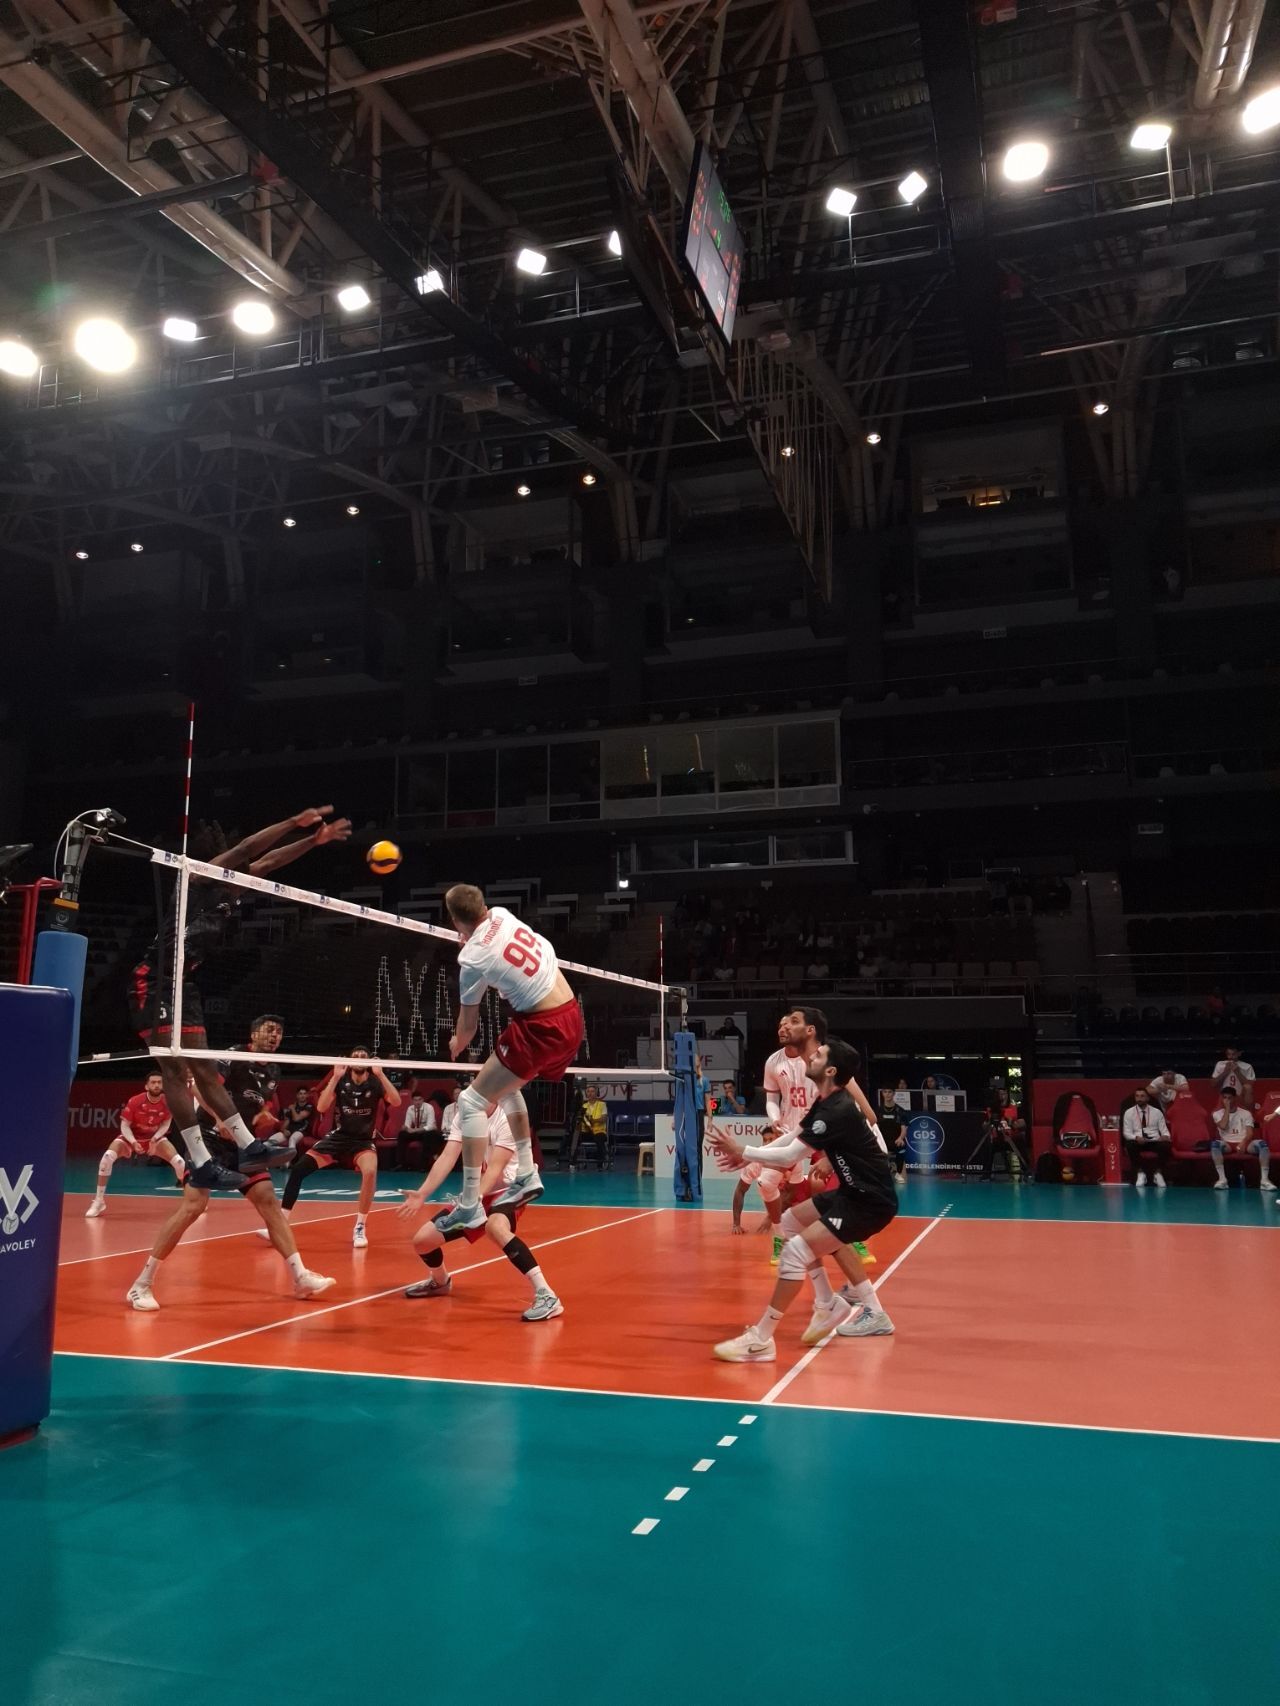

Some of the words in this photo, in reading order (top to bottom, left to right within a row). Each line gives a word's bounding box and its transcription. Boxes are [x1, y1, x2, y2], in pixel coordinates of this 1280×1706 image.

[610, 1084, 638, 1097] TVF
[68, 1104, 122, 1128] TÜRK
[913, 1129, 937, 1140] GDS
